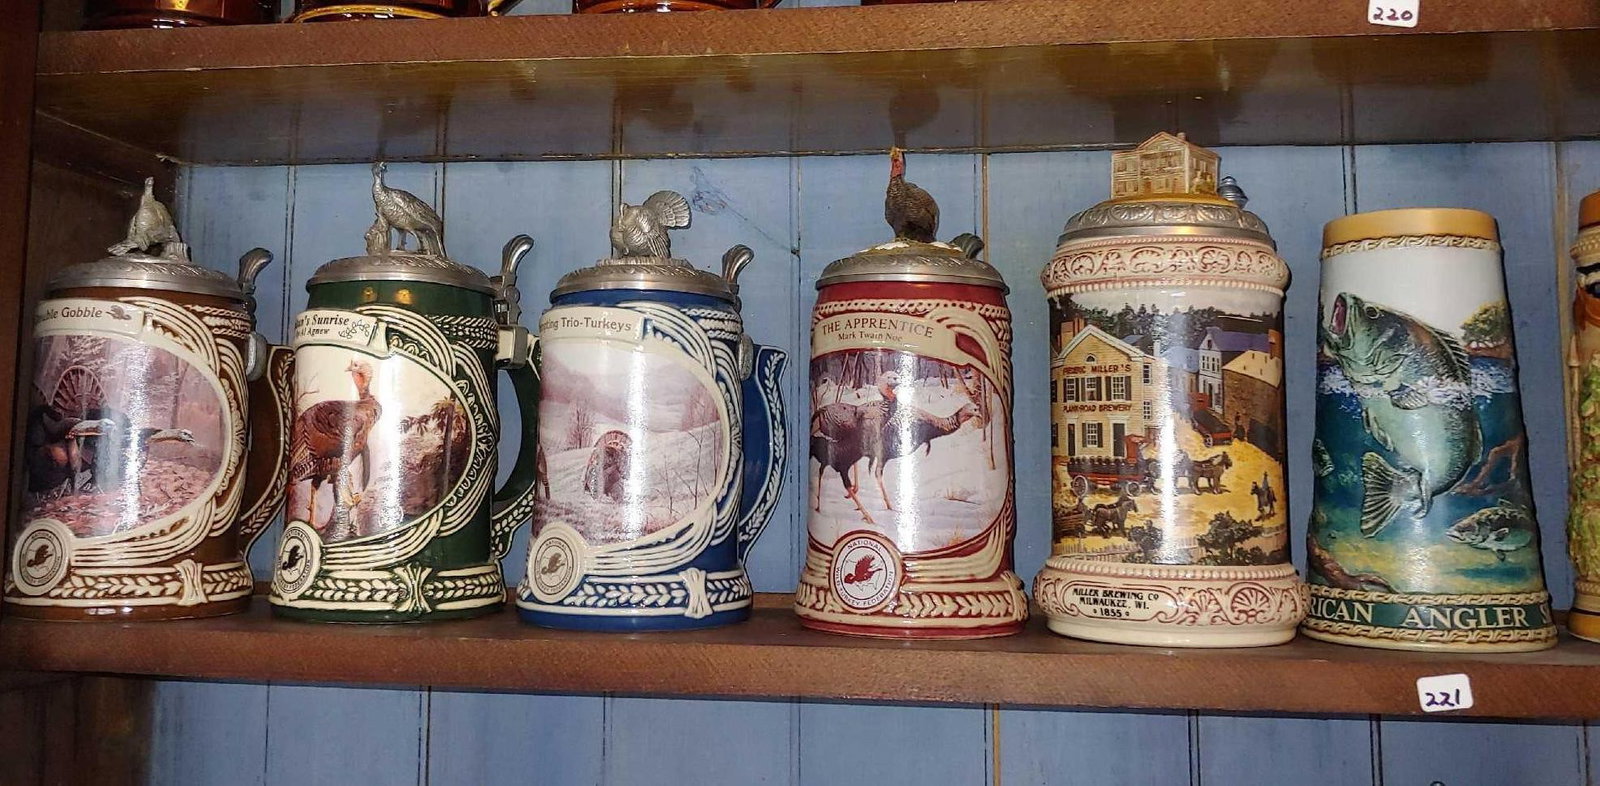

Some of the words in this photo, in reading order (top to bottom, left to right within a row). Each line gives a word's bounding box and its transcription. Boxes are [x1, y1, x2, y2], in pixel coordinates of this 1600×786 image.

[1373, 6, 1413, 21] 220
[61, 306, 102, 318] Gobble
[311, 313, 349, 326] Sunrise
[307, 327, 330, 337] Agnew
[822, 320, 841, 336] THE
[844, 317, 934, 338] APPRENTICE
[838, 331, 857, 341] Mark
[859, 330, 884, 341] Twain
[1098, 404, 1132, 412] BREWERY
[1072, 588, 1099, 597] MILLER
[1102, 589, 1144, 600] BREWING
[1147, 592, 1160, 600] CO
[1100, 607, 1123, 617] 1855
[1401, 606, 1530, 629] ANGLER
[1425, 688, 1462, 707] 221
